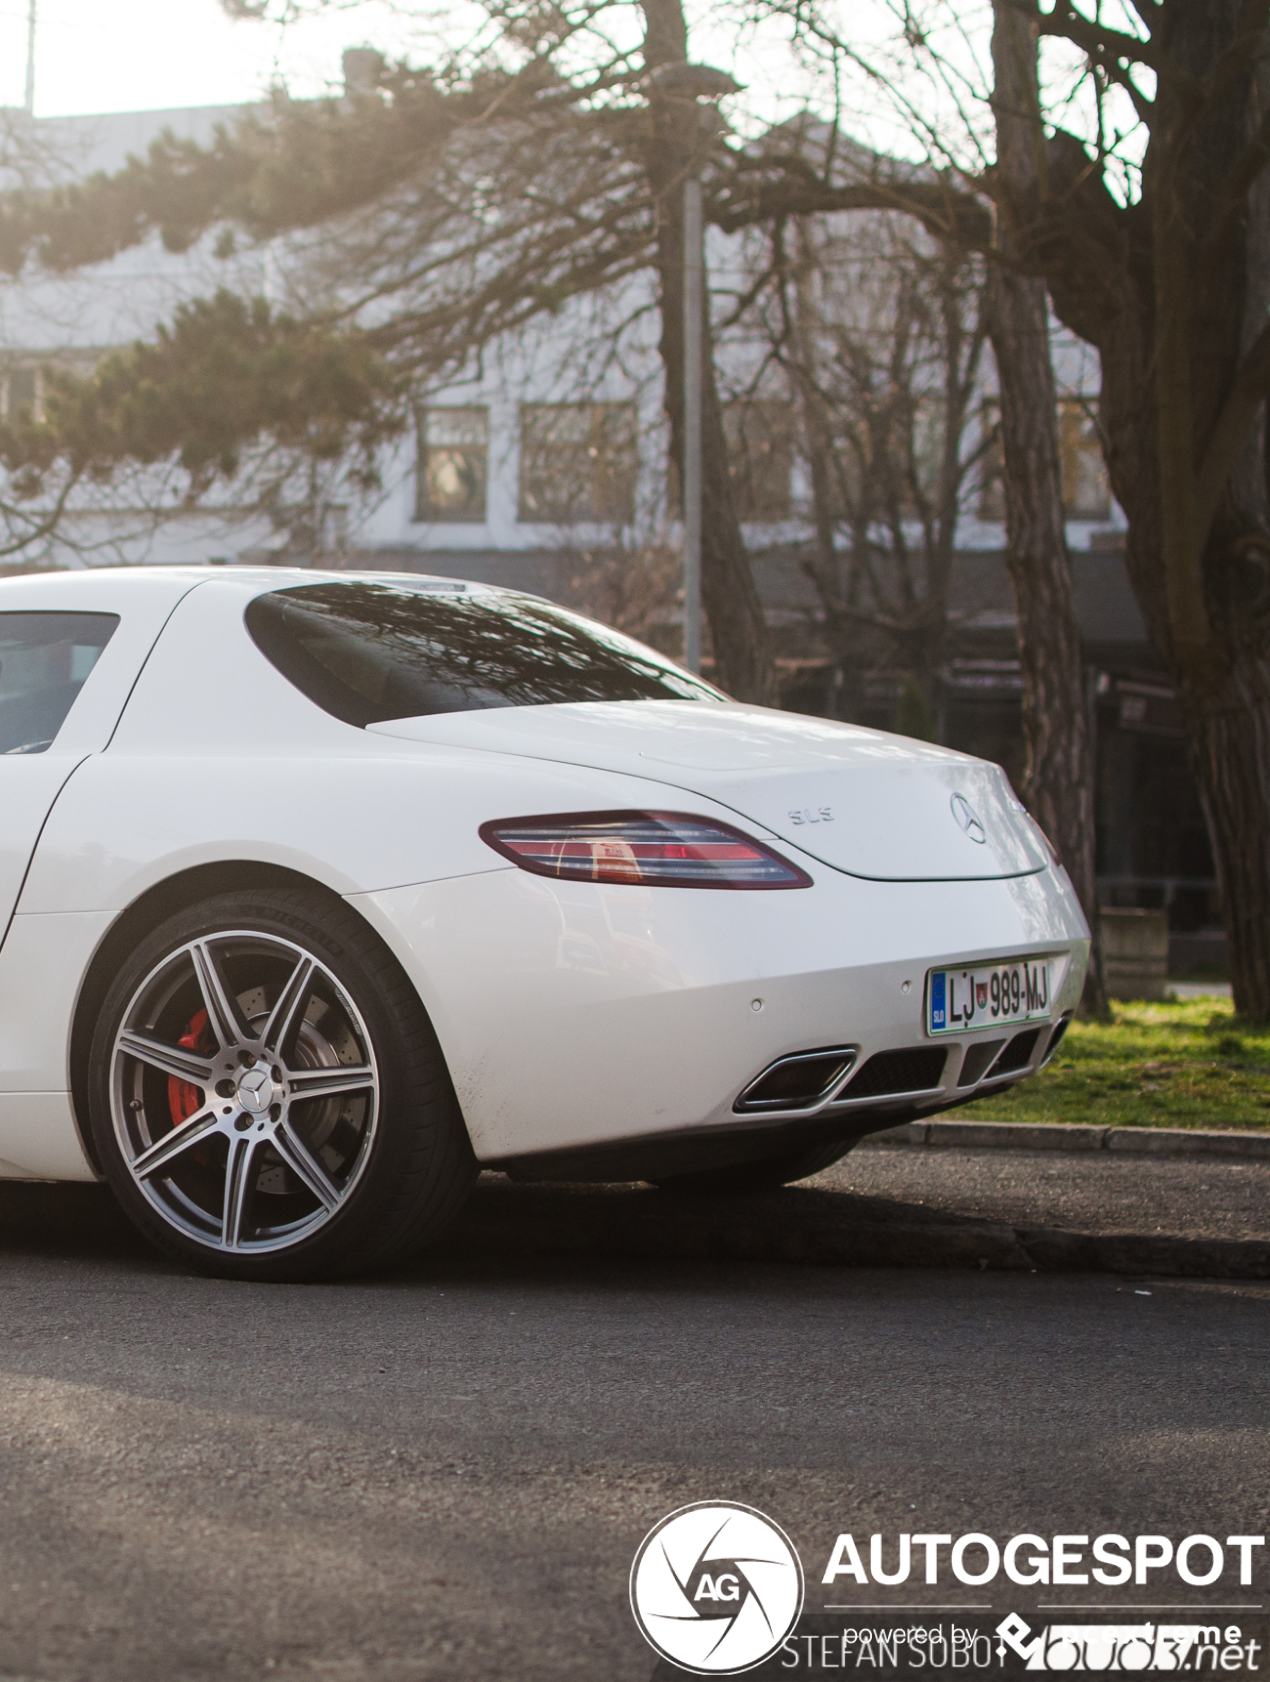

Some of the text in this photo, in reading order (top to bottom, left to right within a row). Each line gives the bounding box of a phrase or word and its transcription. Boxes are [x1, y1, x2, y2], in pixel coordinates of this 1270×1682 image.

[787, 807, 835, 825] SLS
[950, 965, 1048, 1023] LJ 989-MJ
[933, 1010, 945, 1024] SLO
